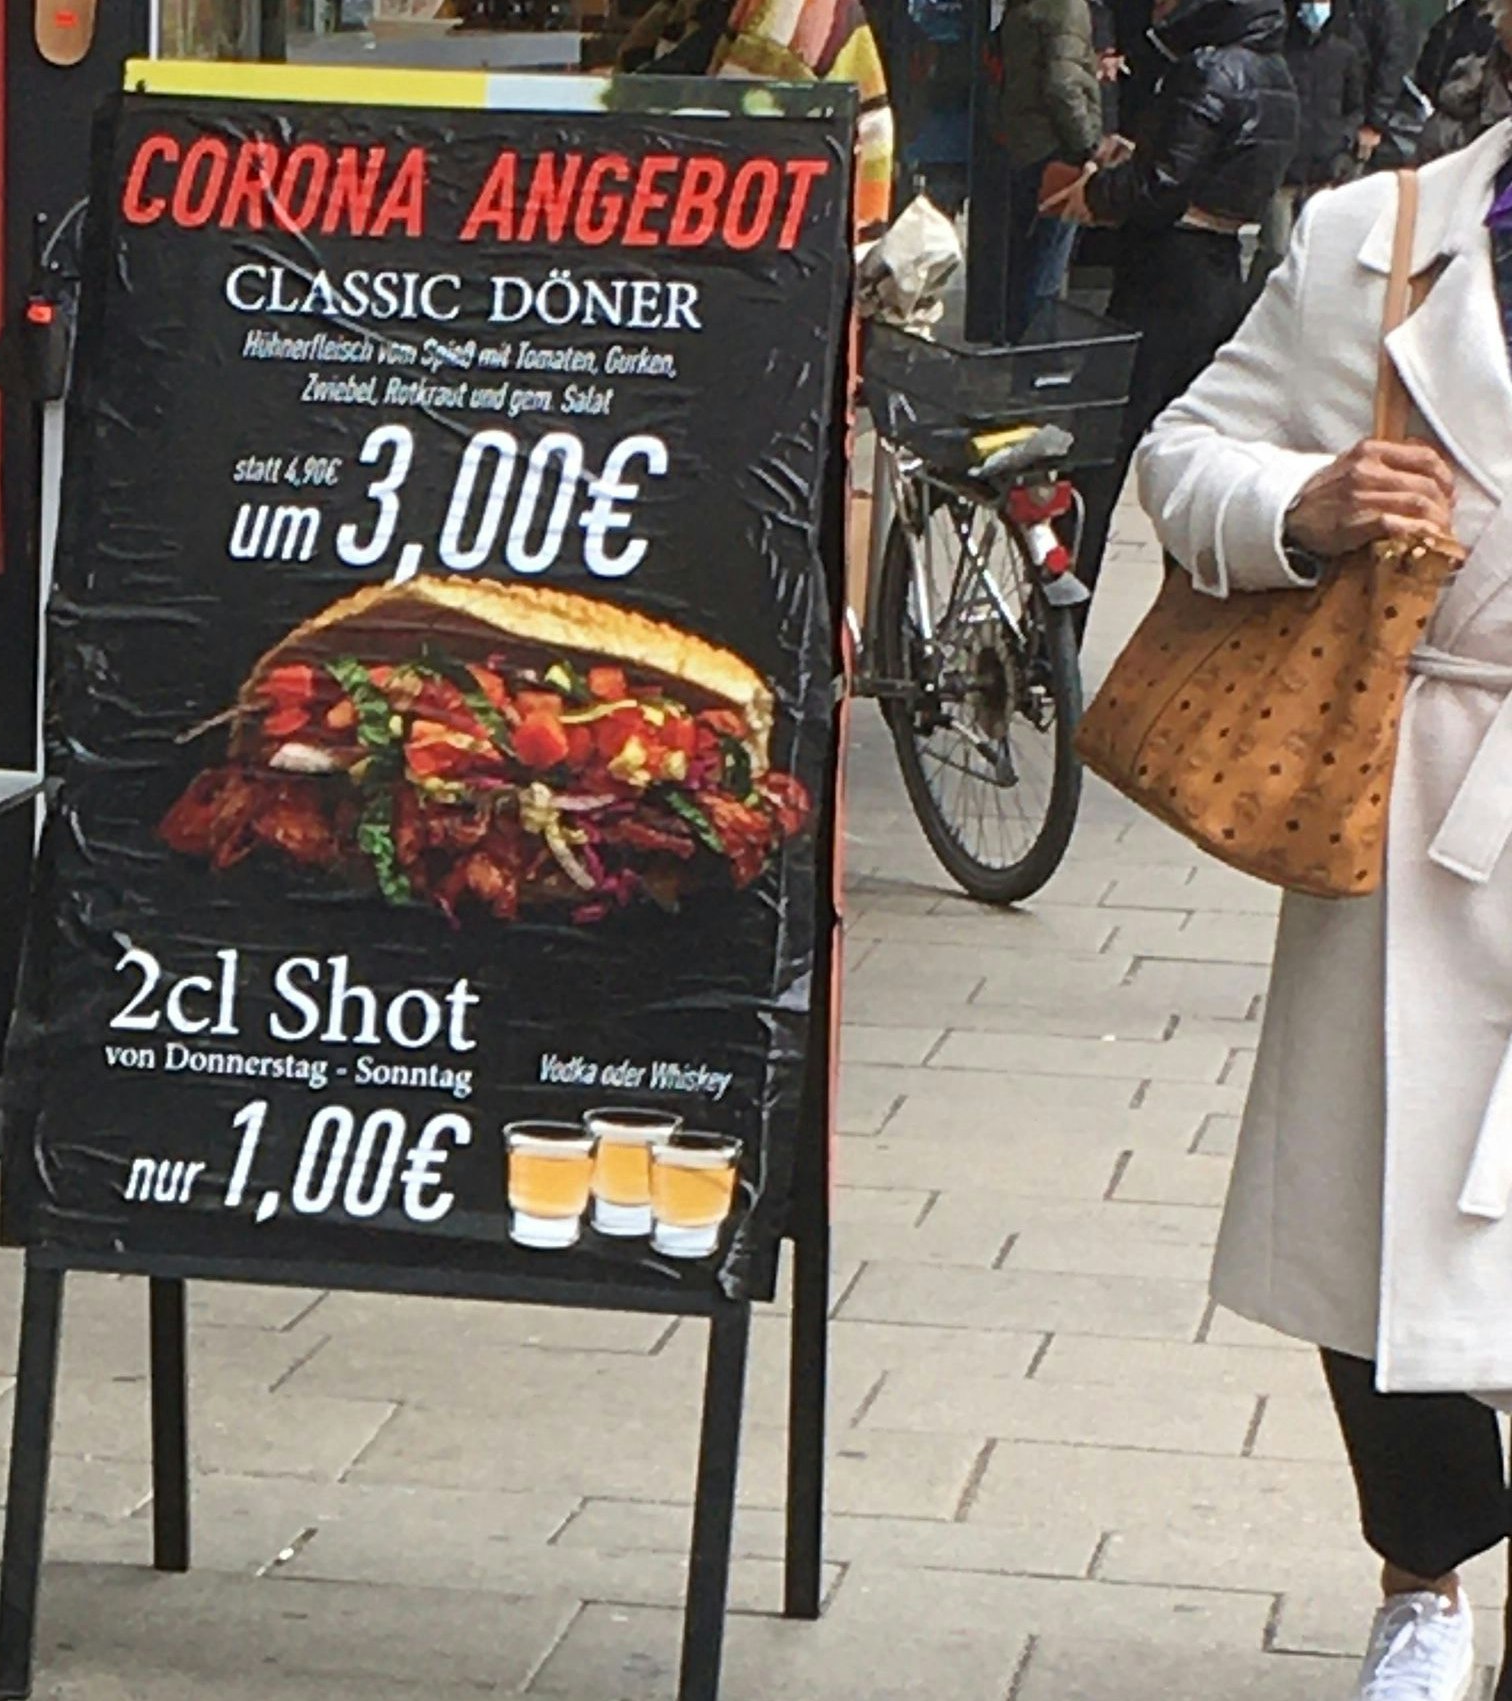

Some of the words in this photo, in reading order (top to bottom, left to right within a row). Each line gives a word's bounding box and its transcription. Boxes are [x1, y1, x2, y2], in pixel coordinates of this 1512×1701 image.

[123, 136, 427, 237] CORONA
[458, 151, 829, 250] ANGEBOT
[226, 263, 461, 321] CLASSIC
[489, 268, 702, 328] DÖNER
[243, 329, 374, 362] Hühnerfleisch
[378, 340, 418, 365] vom
[421, 337, 477, 373] Spieß
[478, 341, 511, 369] mit
[515, 341, 599, 374] Tomaten,
[604, 345, 677, 379] Gurken,
[301, 373, 379, 406] Zwiebel,
[384, 376, 469, 408] Rotkraut
[469, 381, 509, 410] und
[561, 384, 614, 415] Salat
[233, 455, 284, 485] statt
[284, 457, 342, 489] 4,90€
[229, 503, 321, 562] um
[336, 425, 669, 586] 3,00€
[110, 948, 239, 1036] 2cl
[270, 955, 480, 1052] Shot
[105, 1045, 155, 1069] von
[165, 1042, 329, 1090] Donnerstag
[355, 1056, 473, 1098] Sonntag
[540, 1054, 598, 1084] Vodka
[601, 1059, 647, 1087] oder
[649, 1061, 733, 1101] Whiskey
[124, 1158, 206, 1203] nur
[224, 1099, 472, 1224] 1,00€
